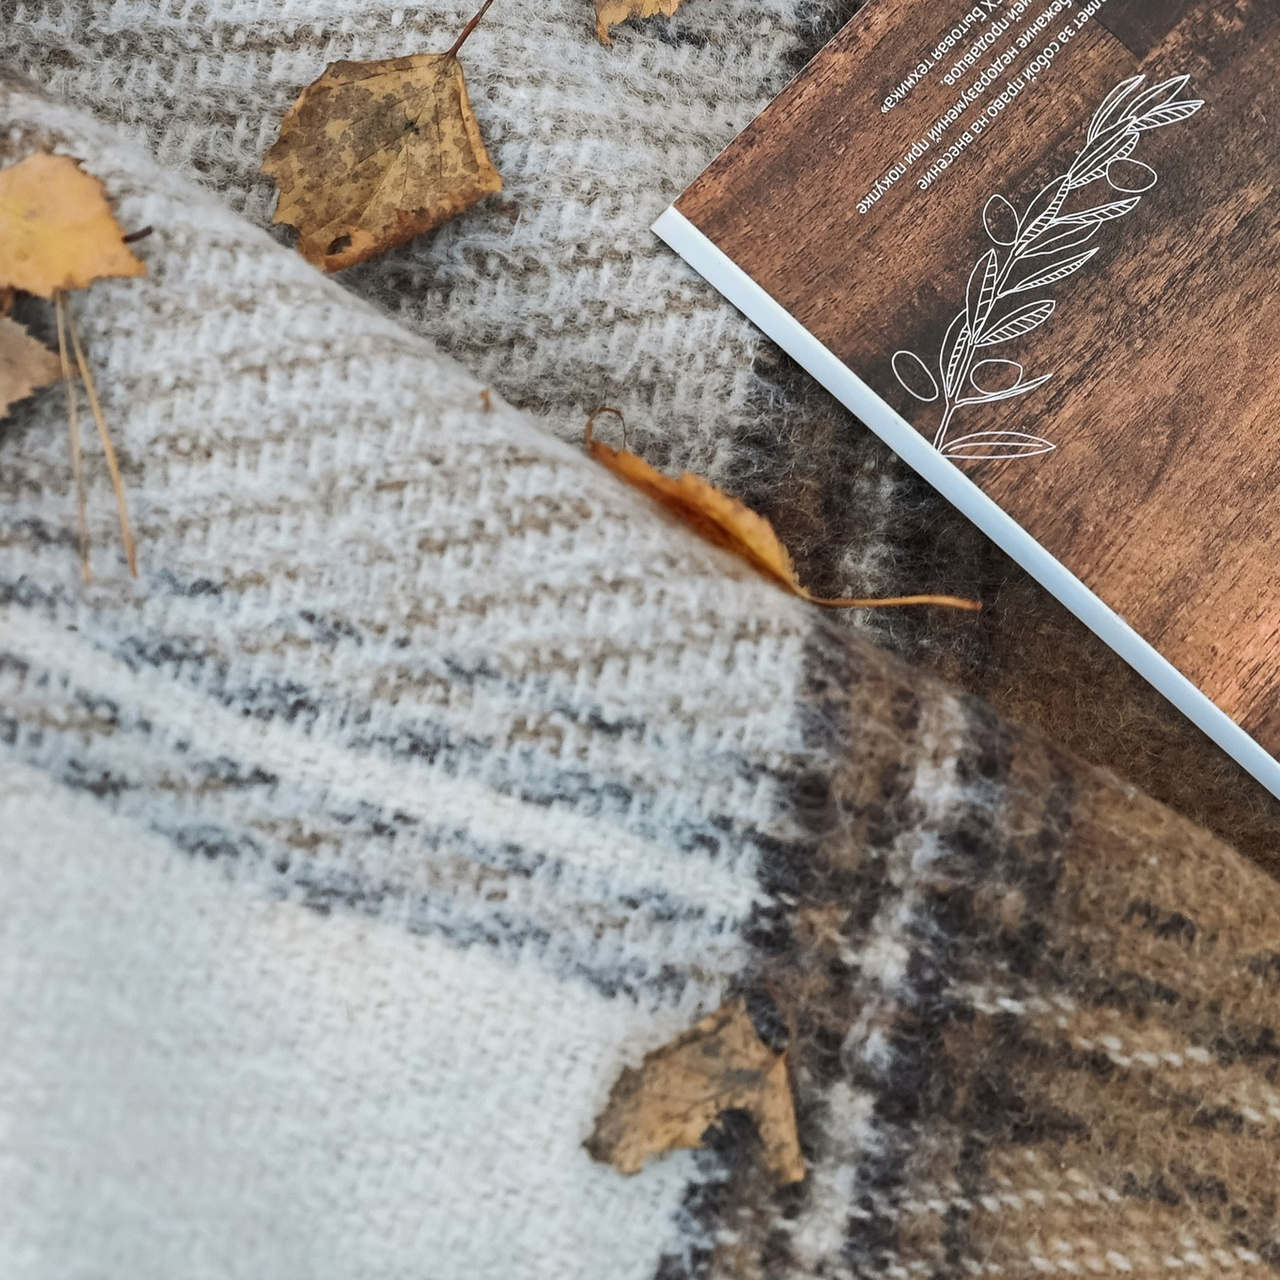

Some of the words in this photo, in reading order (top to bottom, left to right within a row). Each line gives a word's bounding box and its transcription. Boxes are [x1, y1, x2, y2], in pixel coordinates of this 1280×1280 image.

[929, 5, 987, 61] Бытовая
[938, 16, 1010, 86] продавцов.
[1056, 24, 1076, 43] за
[879, 58, 935, 113] техника»
[1020, 40, 1060, 83] собой
[925, 44, 1019, 144] недоразумений
[985, 76, 1026, 117] право
[969, 113, 990, 134] на
[902, 137, 930, 165] при
[915, 130, 974, 190] внесение
[854, 161, 907, 214] покупке
